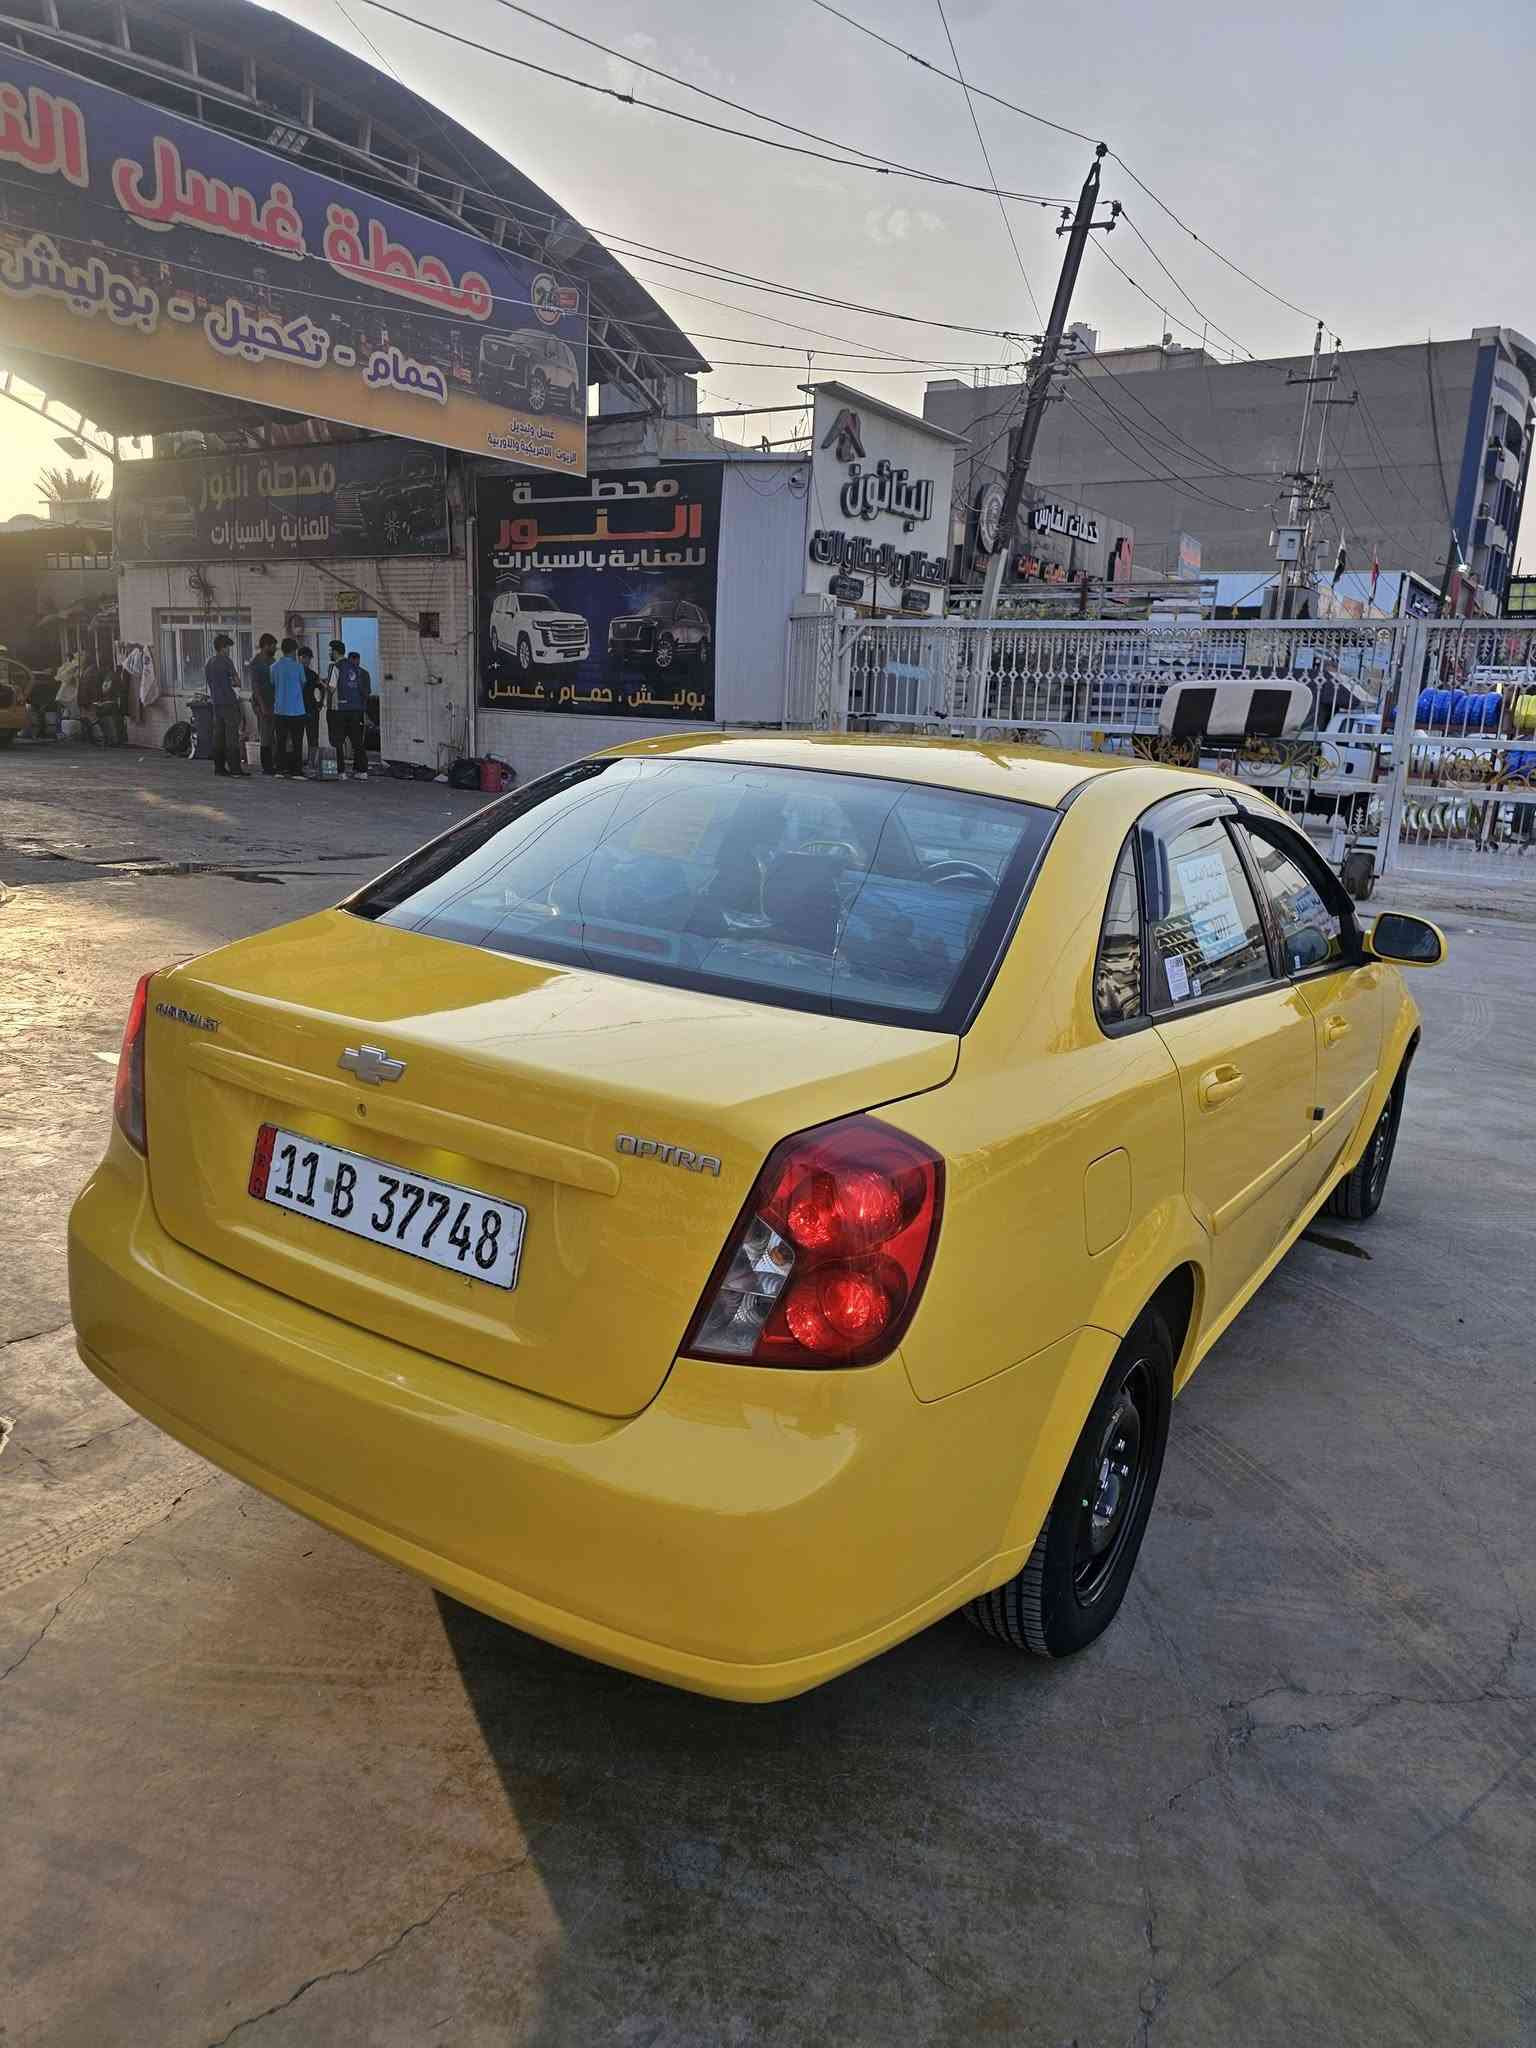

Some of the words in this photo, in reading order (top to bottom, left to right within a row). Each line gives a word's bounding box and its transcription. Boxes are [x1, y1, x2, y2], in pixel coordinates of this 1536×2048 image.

[0, 84, 87, 185] الن
[114, 138, 304, 257] غسل
[325, 205, 491, 319] محطة
[0, 237, 157, 331] بوليش
[206, 301, 327, 365] تكحيل
[364, 348, 446, 402] حمام
[199, 464, 249, 512] النور
[257, 459, 336, 497] محطة
[513, 478, 680, 504] محطة
[211, 519, 276, 550] بالسيارات
[281, 513, 329, 548] للعناية
[492, 549, 605, 572] بالسيارات
[608, 547, 706, 570] للعناية
[488, 681, 545, 700] غسل
[558, 686, 612, 705] حمام
[628, 684, 706, 712] بوليش
[615, 1134, 722, 1177] OPTRA
[275, 1144, 320, 1208] 11
[330, 1161, 357, 1218] B
[371, 1174, 502, 1269] 37748
